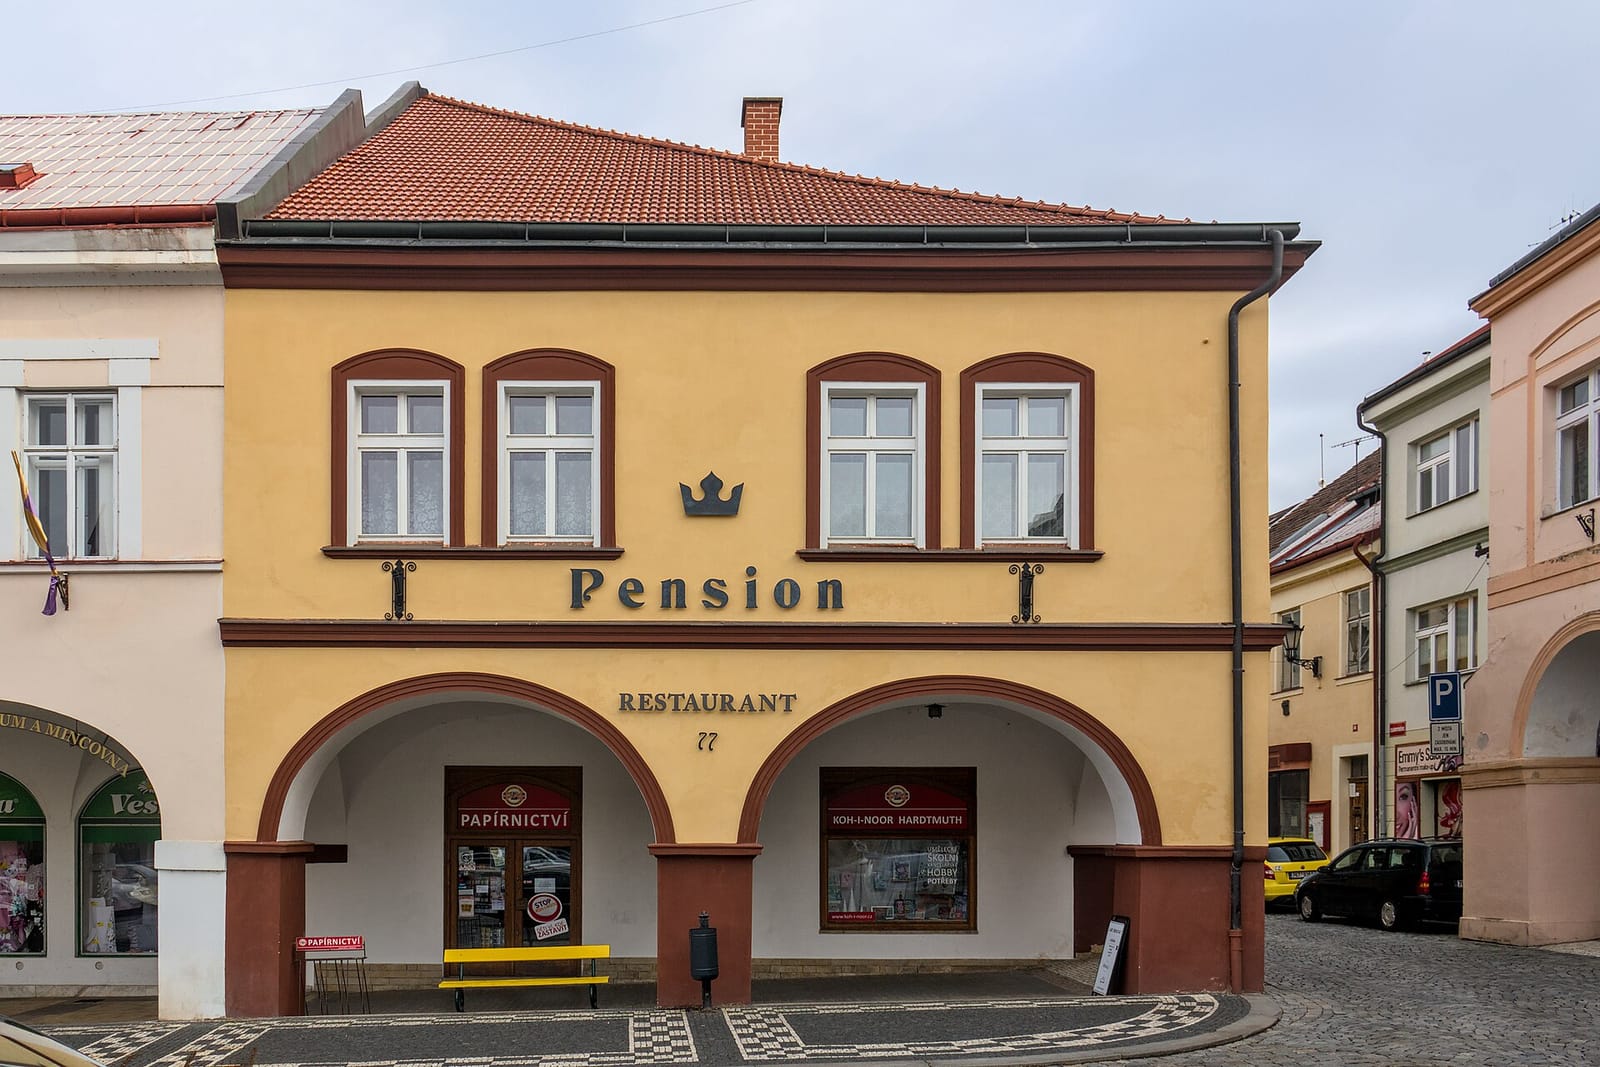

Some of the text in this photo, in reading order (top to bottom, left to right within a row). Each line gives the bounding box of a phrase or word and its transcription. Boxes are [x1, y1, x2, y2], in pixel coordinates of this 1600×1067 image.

[569, 565, 844, 609] Pension
[1435, 679, 1453, 706] P
[618, 692, 798, 713] RESTAURANT
[30, 719, 41, 734] A
[45, 722, 130, 778] MINCOVNA
[698, 732, 718, 751] 77
[461, 811, 568, 827] PAPÍRNICTVÍ
[833, 815, 962, 825] KOH-I-NOOR HARDTMUTH
[927, 868, 957, 877] HOBBY
[534, 898, 551, 909] STOP
[308, 936, 360, 946] PAPÍRNICTVÍ
